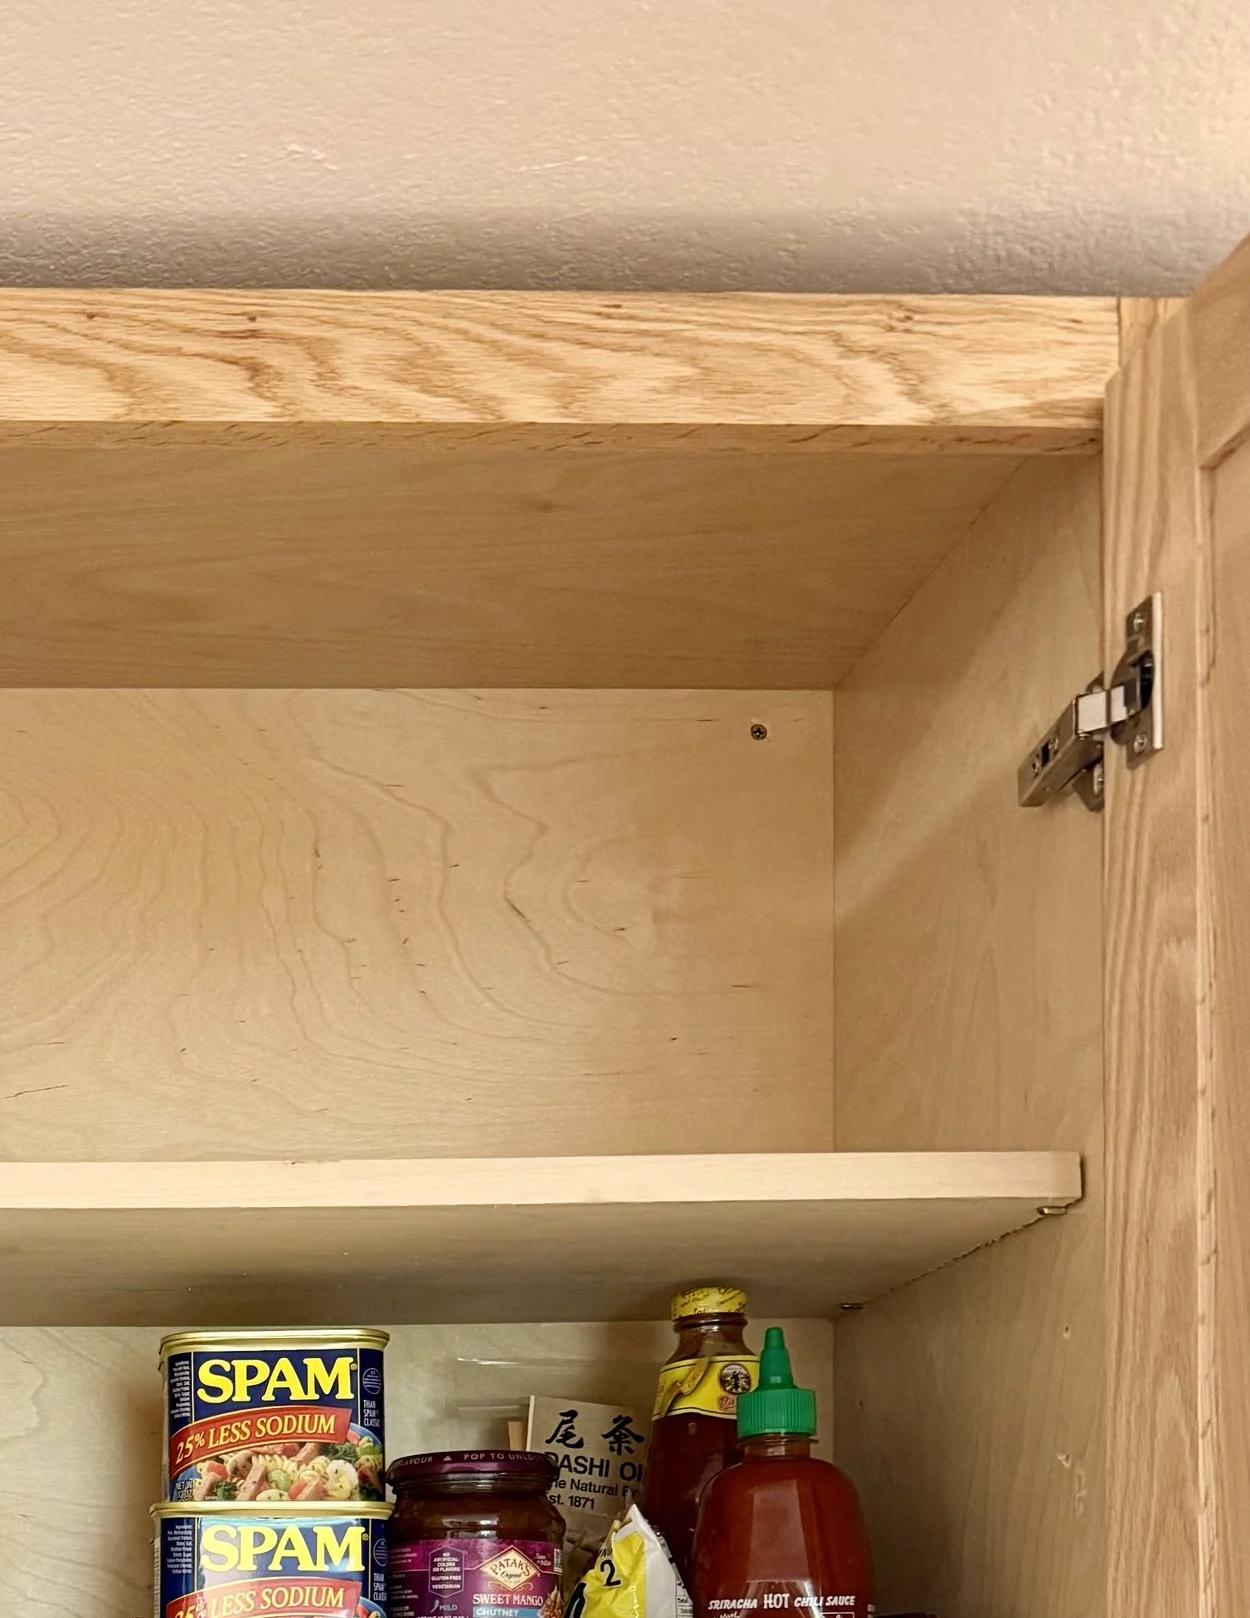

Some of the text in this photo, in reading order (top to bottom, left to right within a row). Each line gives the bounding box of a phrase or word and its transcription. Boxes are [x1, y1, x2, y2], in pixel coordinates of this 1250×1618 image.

[197, 1357, 355, 1404] SPAM
[176, 1414, 336, 1465] 25% LESS SODIUM
[570, 1479, 618, 1497] Natural
[569, 1496, 595, 1510] 1871
[201, 1525, 365, 1572] SPAM
[210, 1591, 255, 1618] LESS
[258, 1587, 344, 1609] SODIUM
[472, 1593, 543, 1606] SWEET MANGO
[708, 1599, 757, 1610] SRIRACHA
[763, 1593, 789, 1609] HOT
[825, 1596, 855, 1606] SAUCE
[476, 1609, 519, 1617] CHUTNEY
